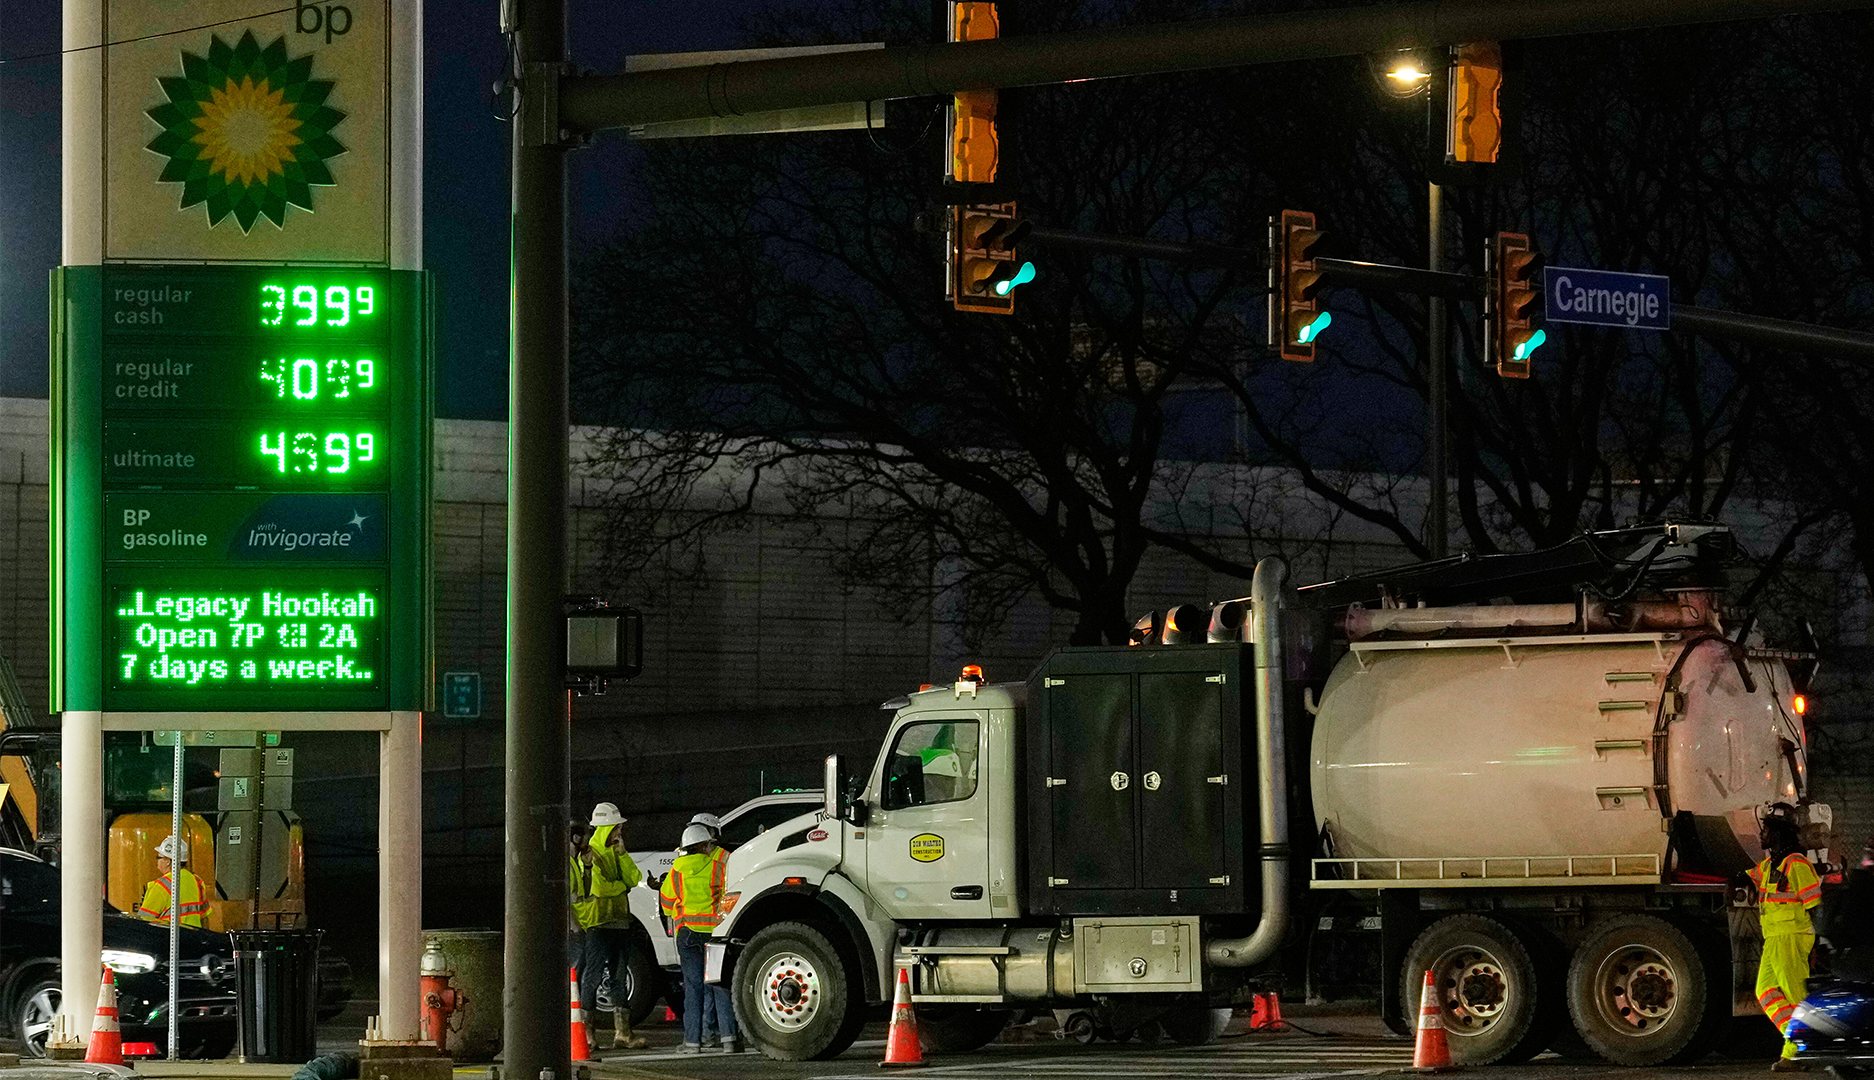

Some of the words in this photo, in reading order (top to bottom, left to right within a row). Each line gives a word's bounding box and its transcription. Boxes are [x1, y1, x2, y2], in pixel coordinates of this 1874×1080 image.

[296, 0, 352, 44] bp
[115, 285, 192, 307] regular
[1555, 275, 1659, 325] Carnegie
[114, 307, 164, 325] cash
[115, 358, 194, 380] regular
[115, 380, 179, 399] credit
[114, 449, 196, 468] ultimate
[123, 509, 151, 527] BP
[257, 522, 278, 531] with
[123, 529, 208, 550] gasoline
[248, 529, 352, 551] Invigorate
[262, 591, 375, 617] Hookah
[134, 622, 217, 653] Open
[229, 623, 265, 648] 7P
[318, 623, 358, 648] 2A
[121, 653, 138, 679] 7
[150, 654, 229, 684] days
[240, 660, 256, 679] a
